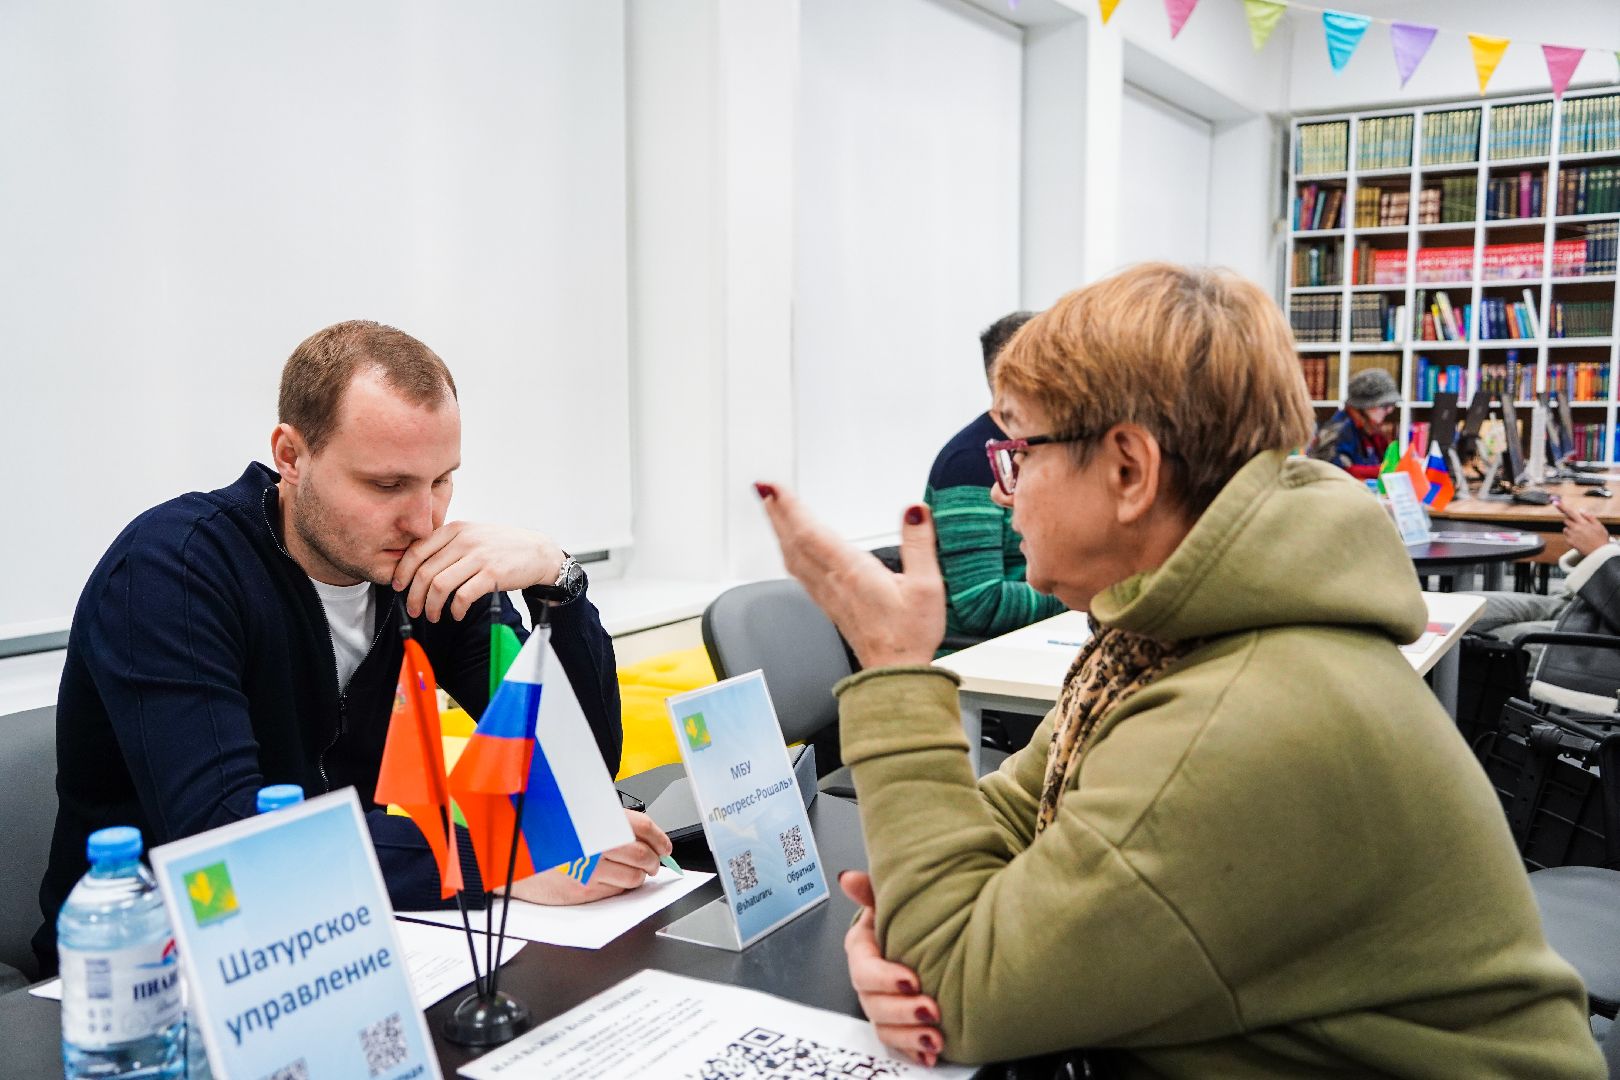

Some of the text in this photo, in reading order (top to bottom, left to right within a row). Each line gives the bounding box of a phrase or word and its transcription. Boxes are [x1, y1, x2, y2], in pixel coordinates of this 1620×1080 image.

[730, 760, 751, 780] МБУ
[708, 777, 793, 822] «Прогресс-Рошаль»
[786, 862, 816, 884] Обратная
[797, 881, 815, 896] связь
[218, 905, 372, 985] Шатурское
[225, 947, 392, 1046] управление
